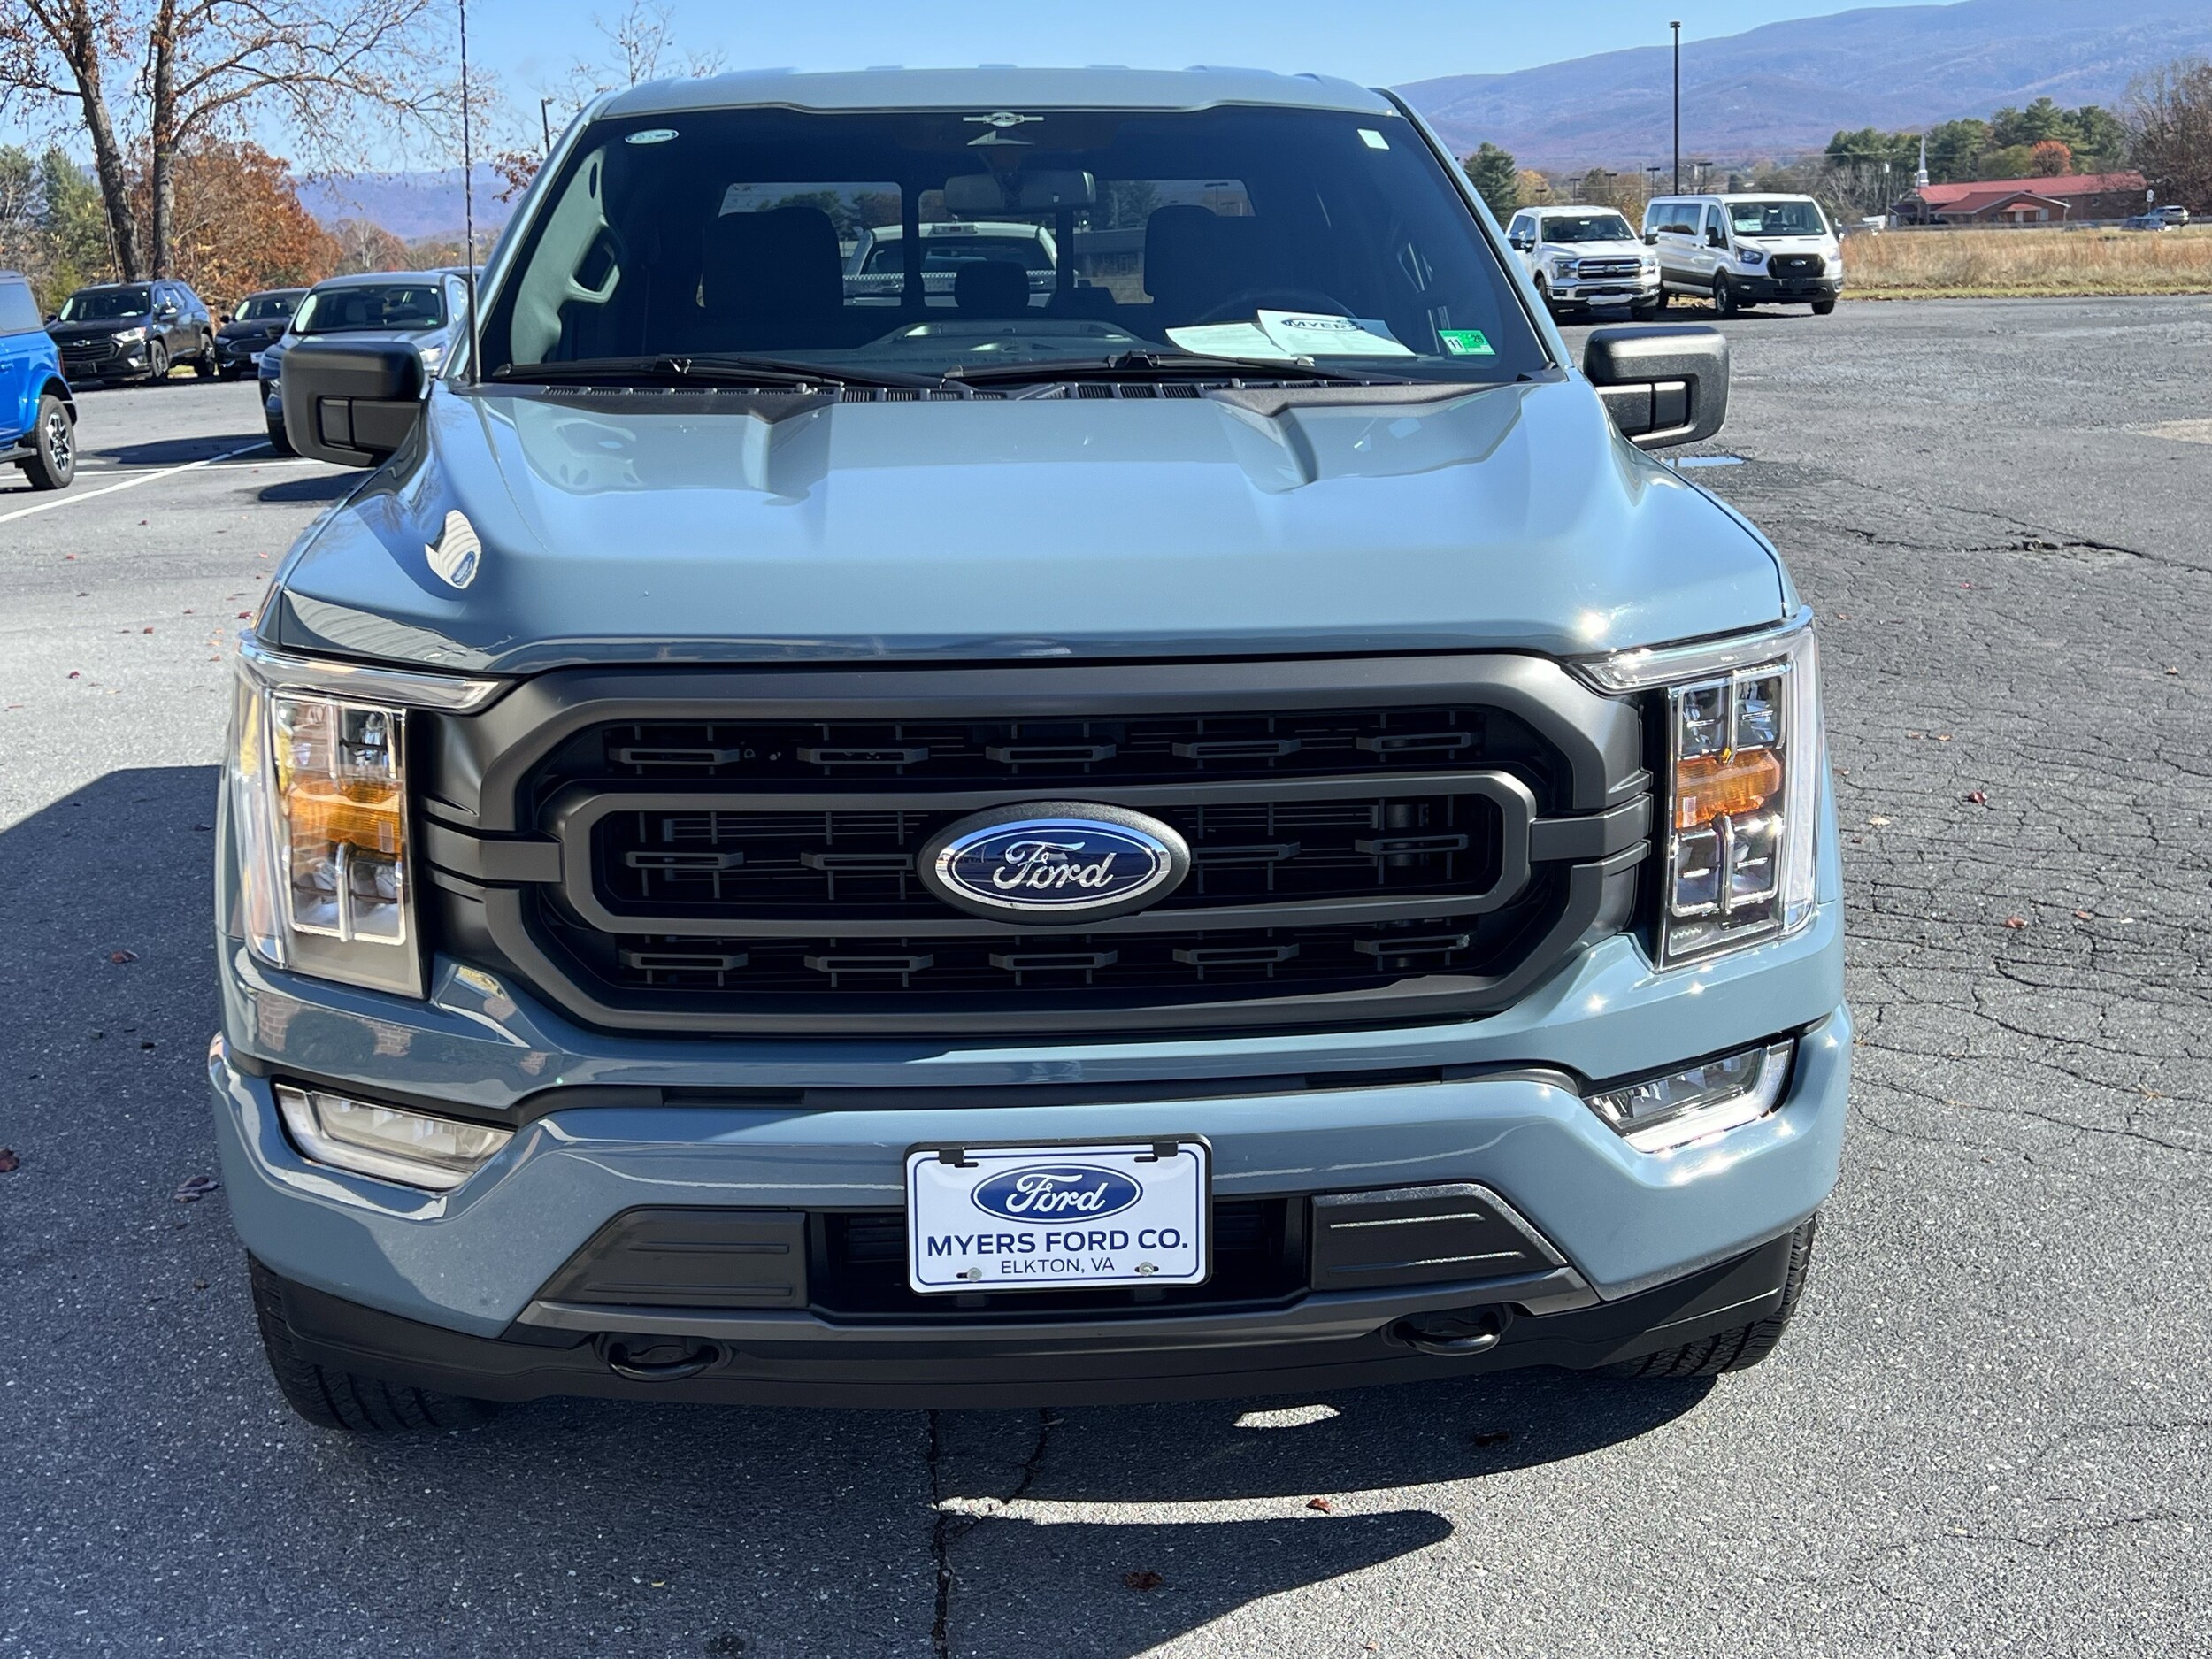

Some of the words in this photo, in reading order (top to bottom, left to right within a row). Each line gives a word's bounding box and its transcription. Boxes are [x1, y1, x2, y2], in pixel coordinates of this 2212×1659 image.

[1448, 339, 1463, 349] 11
[993, 841, 1117, 889] Ford
[1005, 1173, 1108, 1212] Ford
[928, 1233, 1036, 1256] MYERS
[1046, 1229, 1129, 1253] FORD
[1138, 1228, 1188, 1250] CO.
[1001, 1258, 1085, 1275] ELKTON,
[1090, 1257, 1115, 1271] VA
